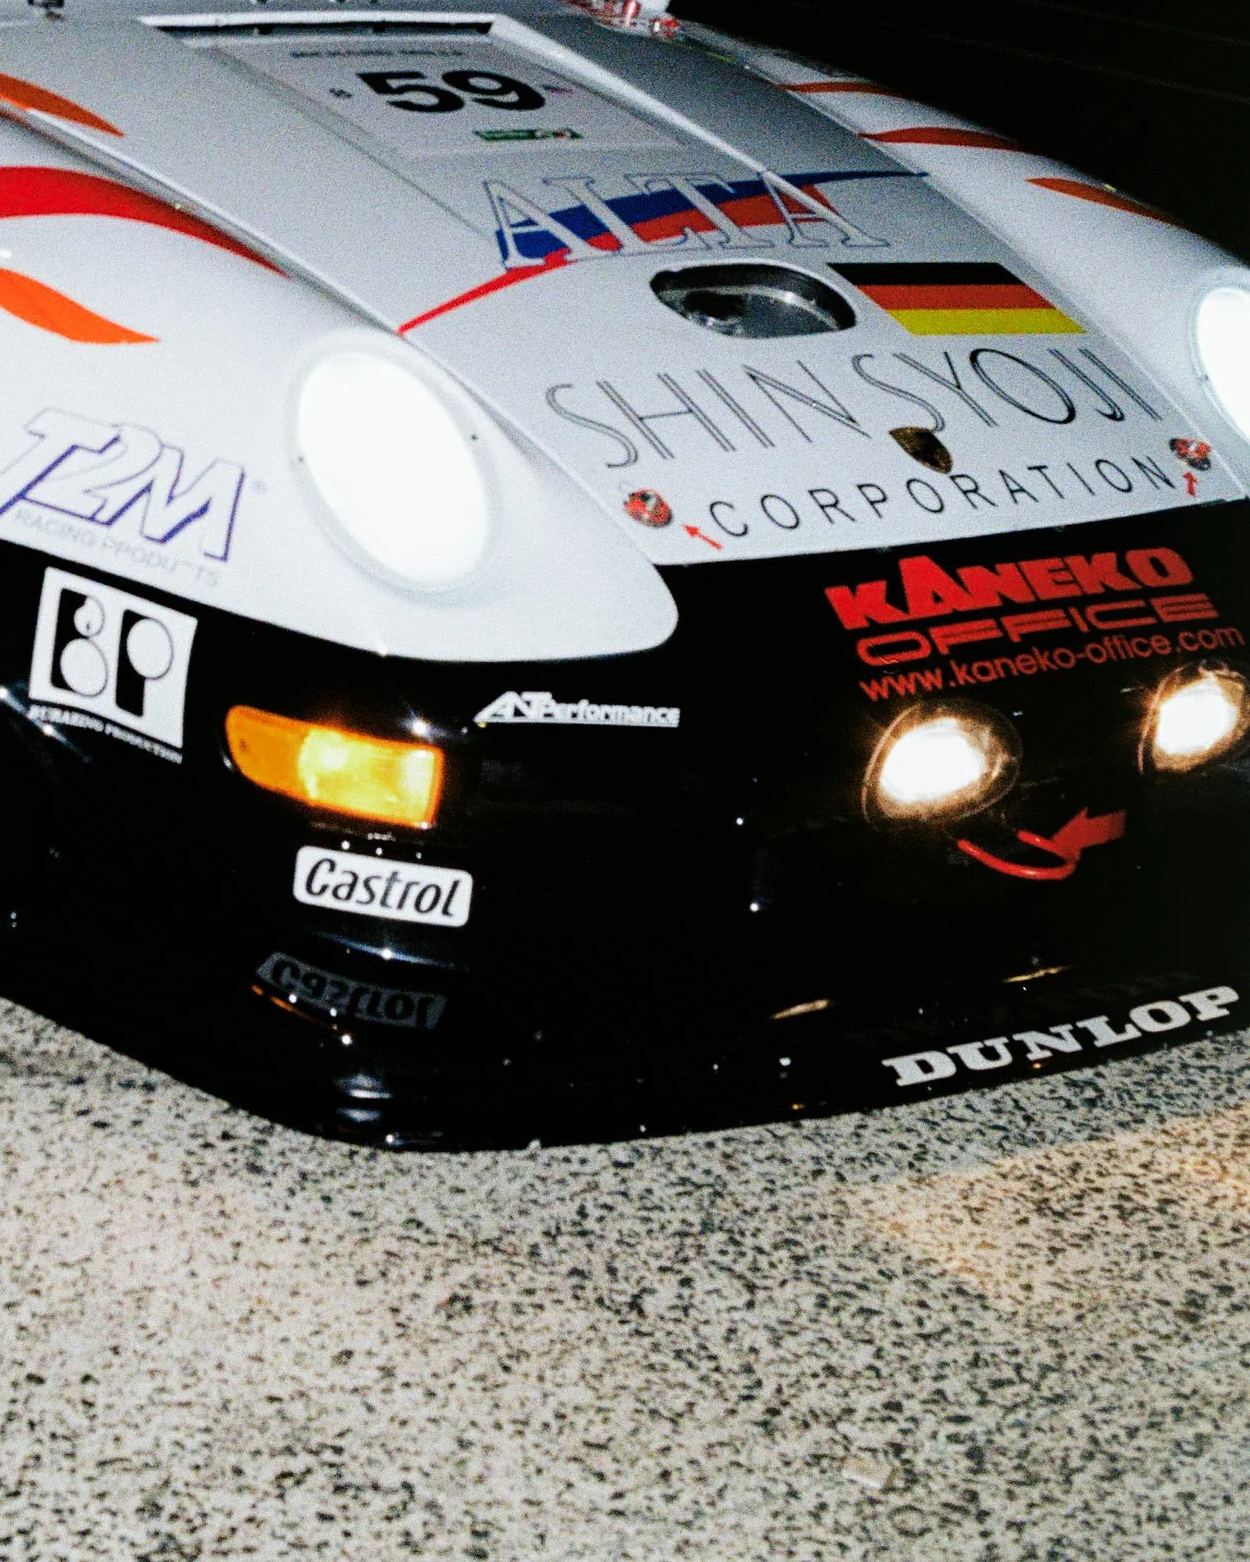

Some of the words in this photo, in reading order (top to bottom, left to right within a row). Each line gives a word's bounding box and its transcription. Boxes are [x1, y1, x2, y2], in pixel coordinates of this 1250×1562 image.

[356, 69, 546, 114] 59
[709, 455, 1176, 539] CORPORATION
[824, 546, 1193, 631] KANEKO
[856, 593, 1220, 667] OFFICE
[858, 626, 1245, 702] www.kaneko-office.com
[306, 858, 461, 917] Castrol
[882, 986, 1240, 1086] DUNLOP
